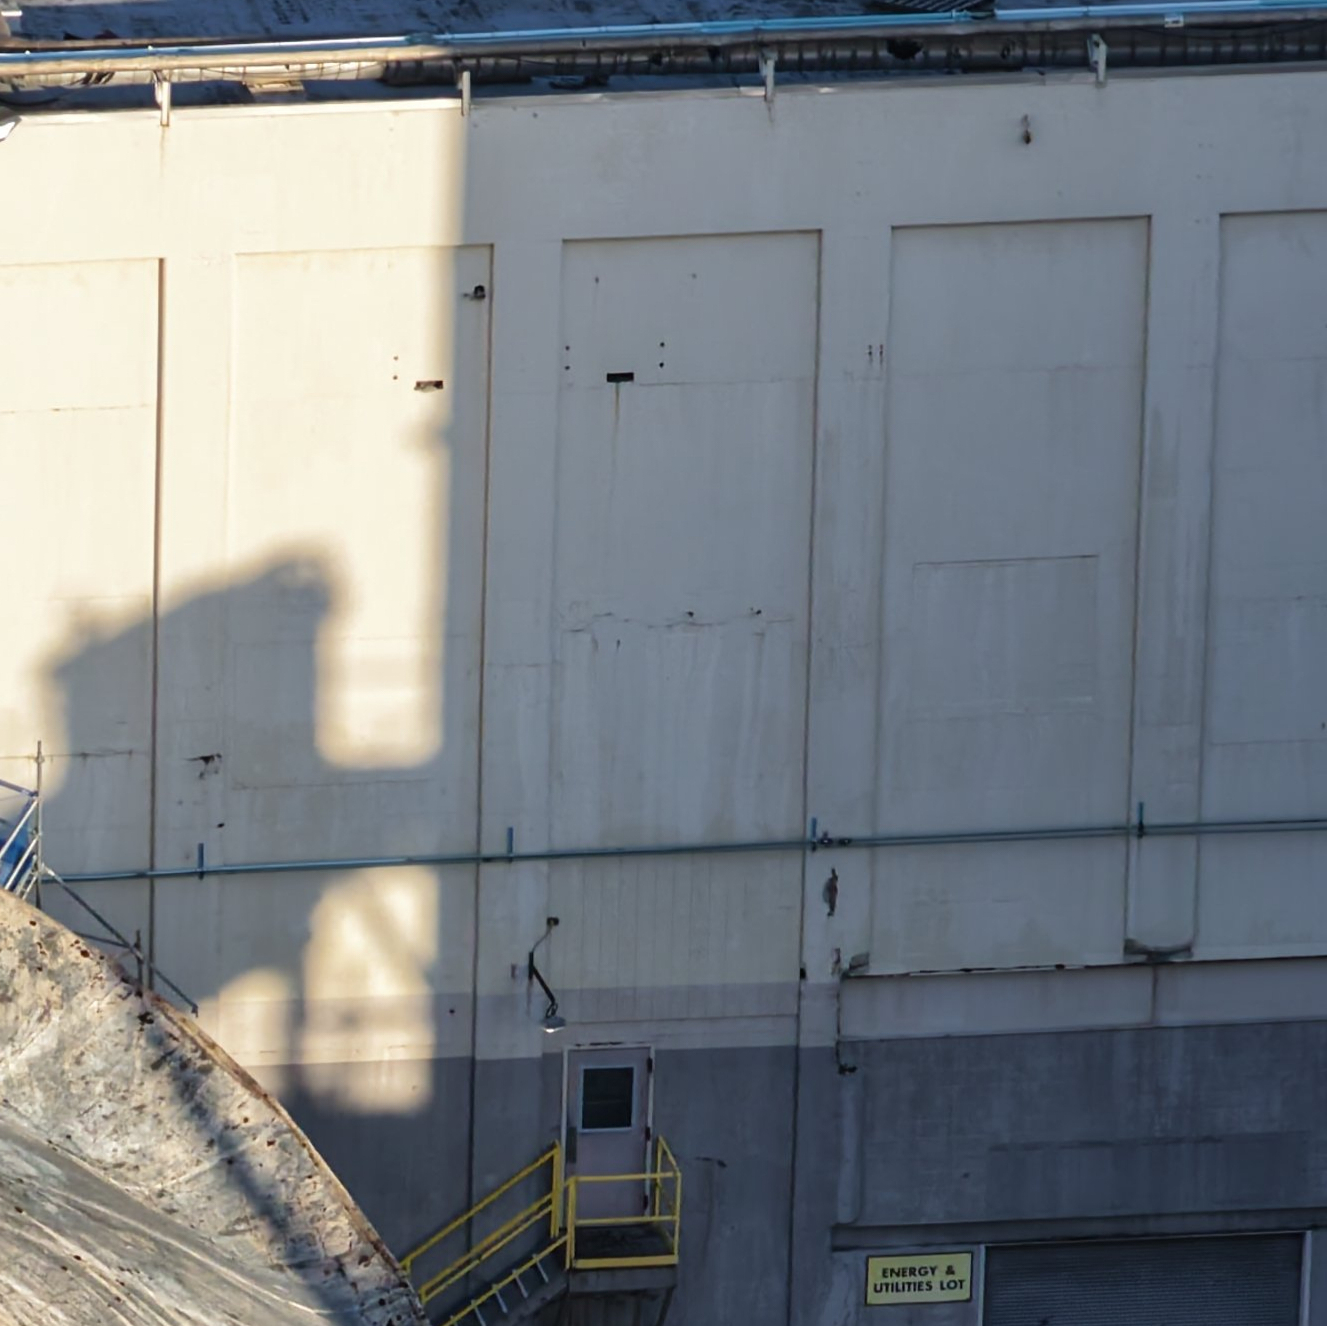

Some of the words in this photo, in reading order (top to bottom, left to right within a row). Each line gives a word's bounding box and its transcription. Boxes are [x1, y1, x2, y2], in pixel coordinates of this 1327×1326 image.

[882, 1265, 937, 1278] ENERGY
[946, 1265, 955, 1275] &
[873, 1280, 933, 1293] UTILITIES
[940, 1279, 965, 1290] LOT
